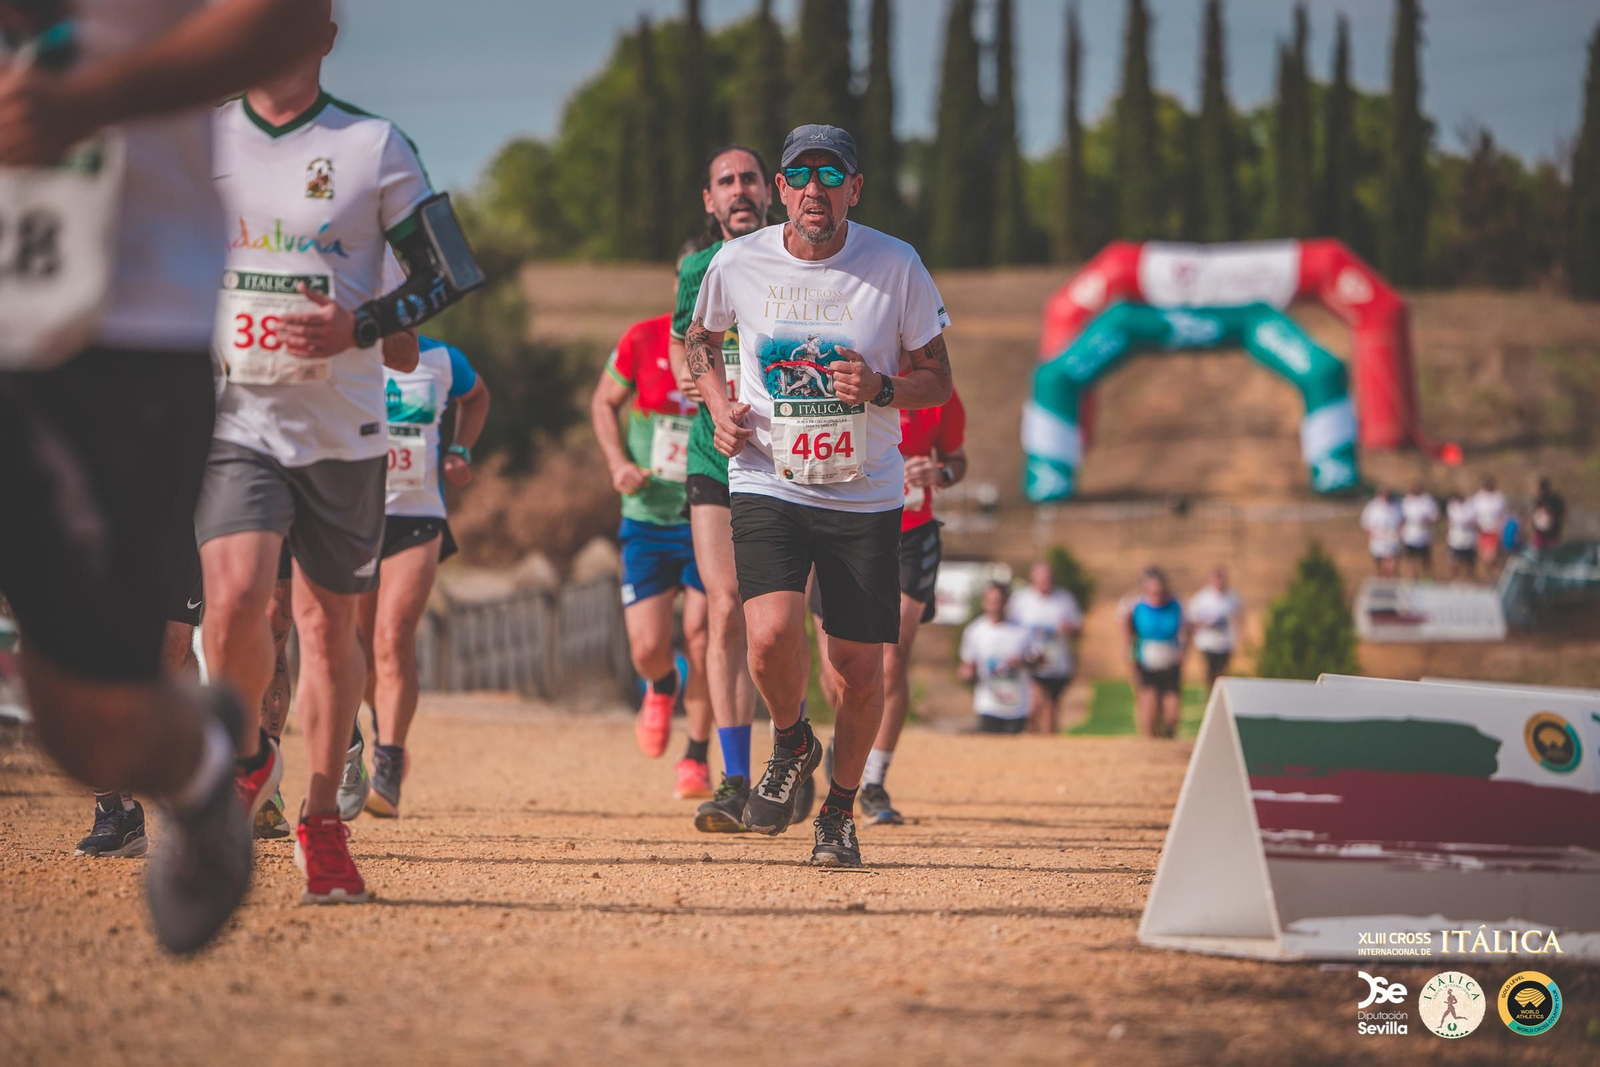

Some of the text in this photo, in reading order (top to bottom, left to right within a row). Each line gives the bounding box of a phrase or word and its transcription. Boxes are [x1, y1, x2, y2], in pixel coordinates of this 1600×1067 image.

[767, 285, 843, 301] XLIII CROSS
[764, 299, 854, 321] ITÁLICA
[234, 312, 284, 351] 38
[799, 403, 844, 414] ITÁLICA
[792, 431, 854, 460] 464
[388, 447, 412, 471] 03
